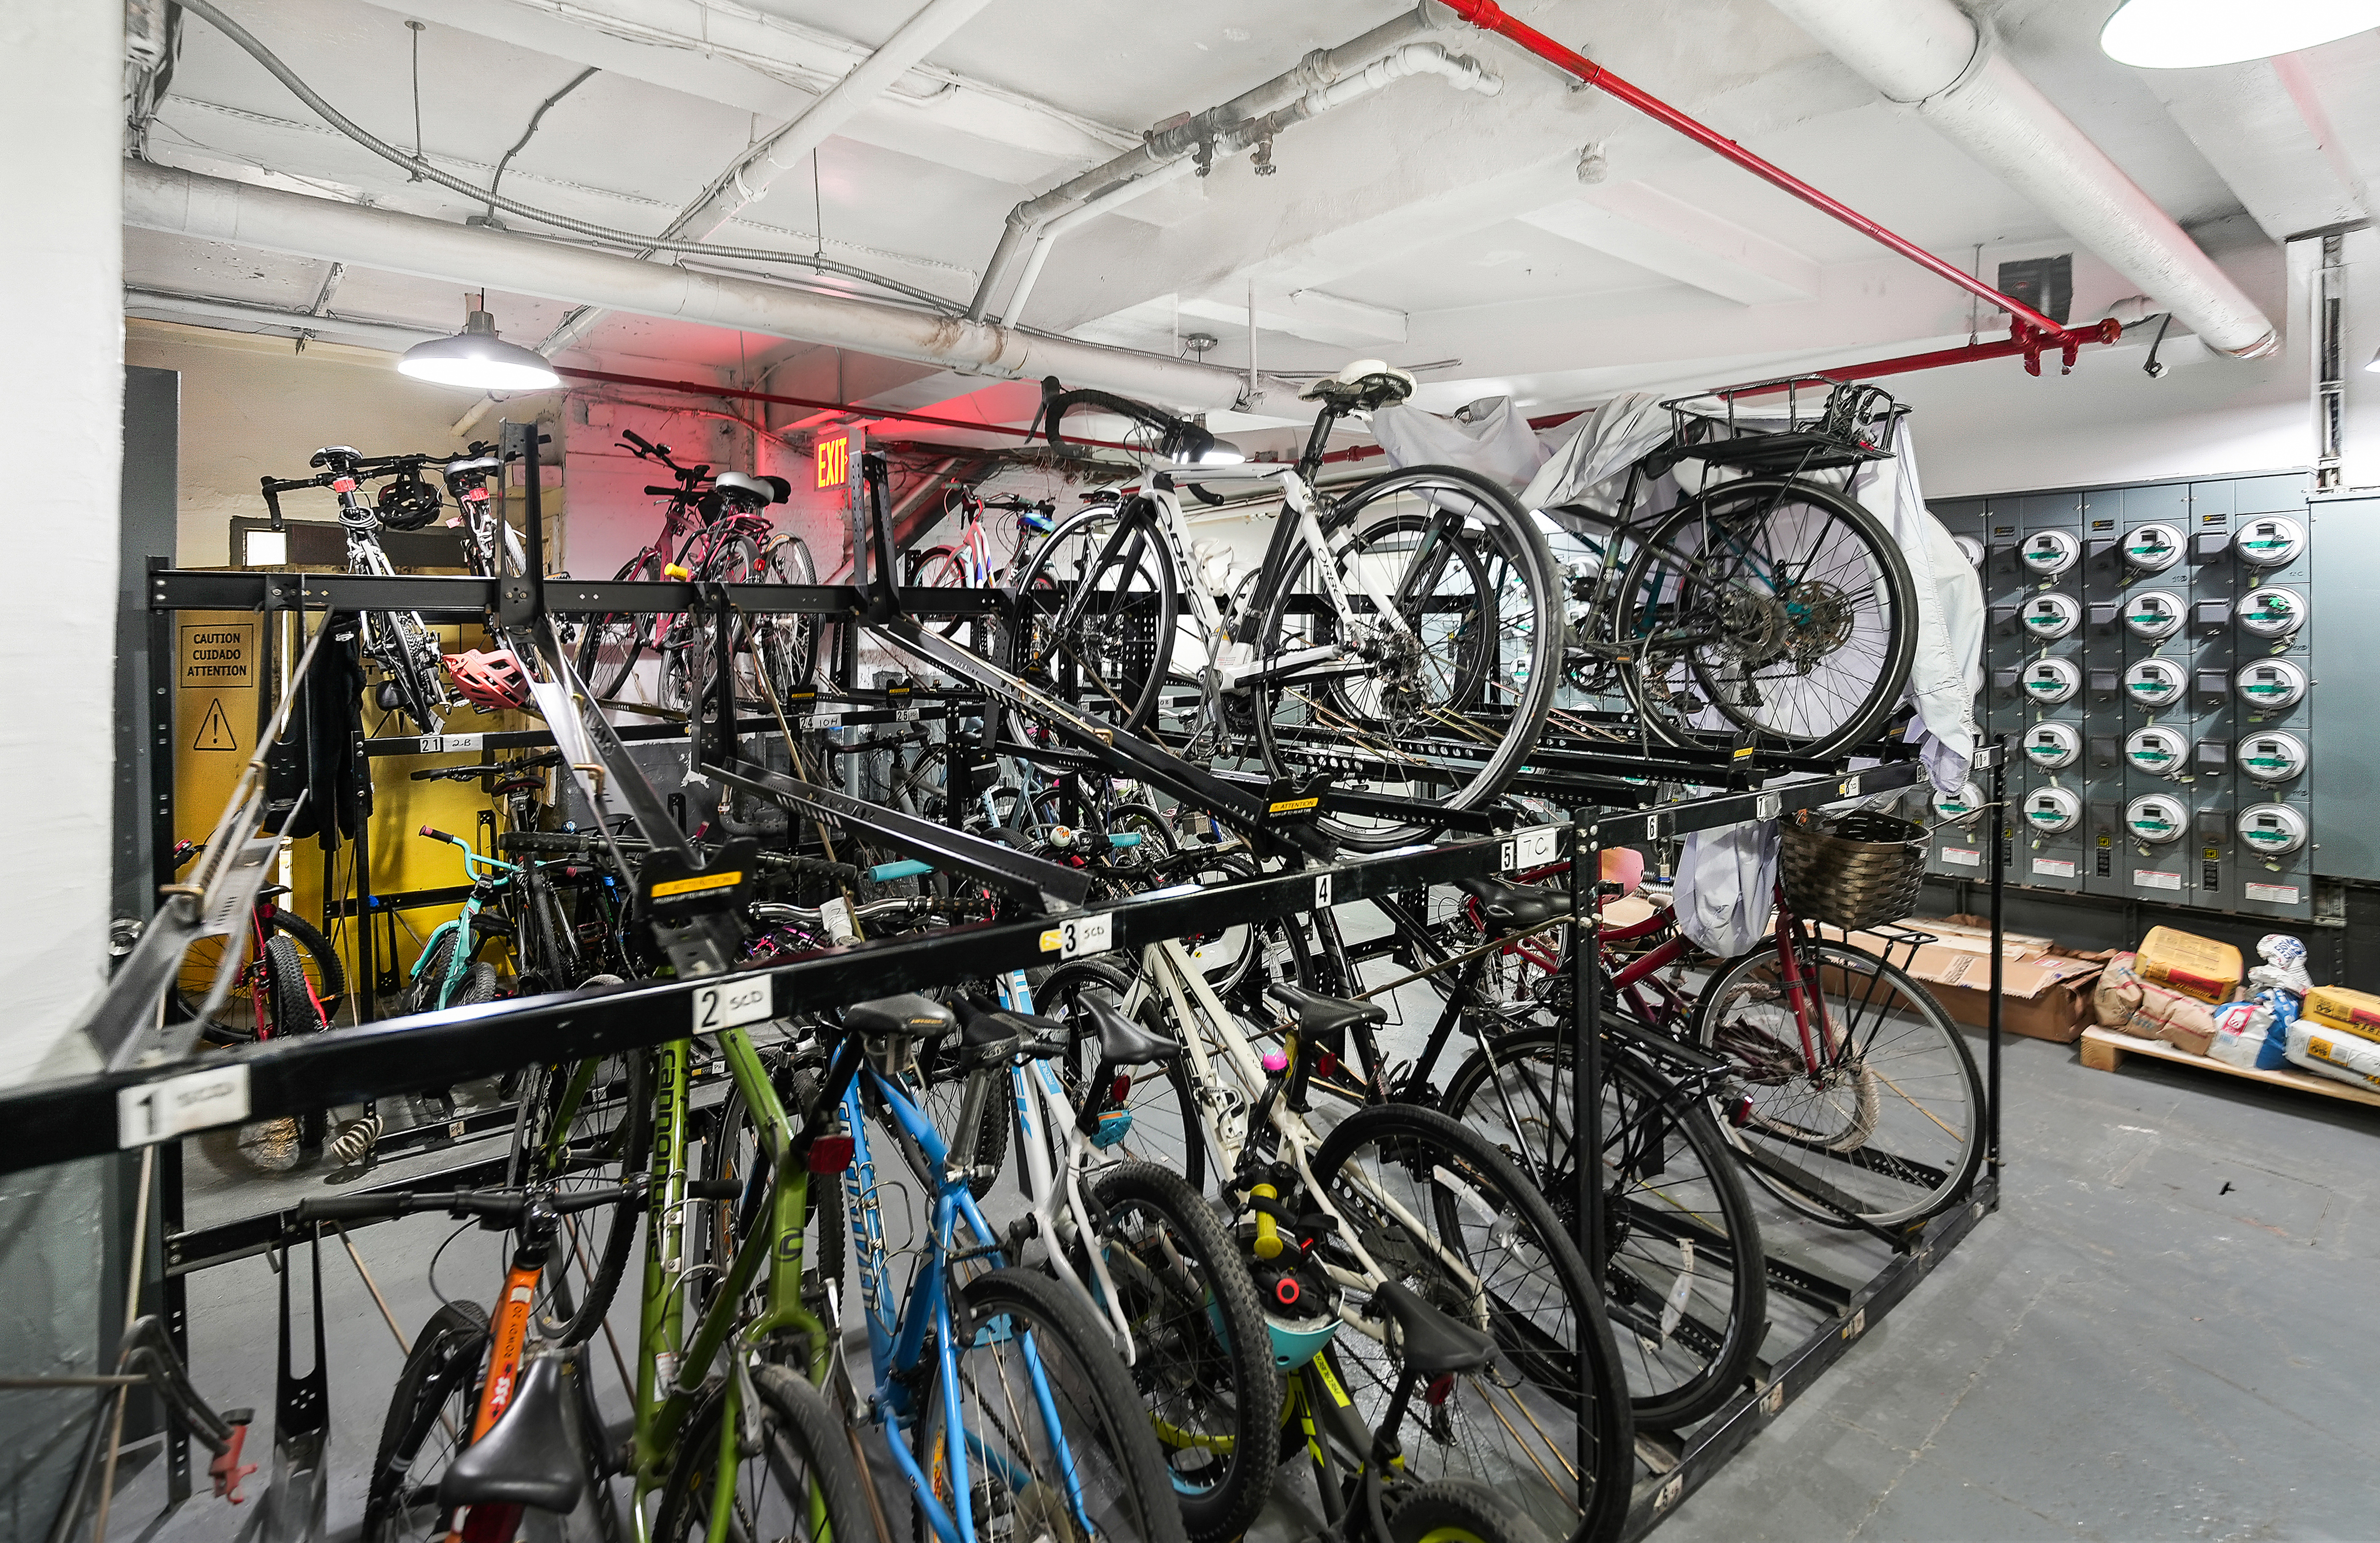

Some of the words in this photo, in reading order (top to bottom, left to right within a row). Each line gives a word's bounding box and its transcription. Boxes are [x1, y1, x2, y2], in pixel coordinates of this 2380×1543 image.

[818, 437, 847, 488] EXIT
[1318, 547, 1346, 614] ORBEA
[194, 633, 240, 644] CAUTION
[193, 649, 241, 660] CUIDADO
[187, 665, 247, 676] ATTENTION
[801, 717, 813, 729] 24
[897, 711, 908, 721] 25
[421, 738, 438, 751] 21
[1976, 753, 1982, 767] 10
[1280, 801, 1314, 810] ATTENTION
[1758, 799, 1763, 815] 7
[1650, 818, 1655, 838] 6
[1504, 845, 1510, 868] 5
[1523, 837, 1547, 858] 7C
[1319, 877, 1328, 903] 4
[1065, 924, 1076, 952] 3
[1084, 926, 1105, 940] SCD
[702, 991, 718, 1028] 2
[730, 990, 763, 1010] SCD
[138, 1093, 155, 1136] 1
[839, 1101, 875, 1310] SPCIALIZED
[504, 1323, 518, 1358] ROWDY
[512, 1306, 522, 1318] 20
[1315, 1355, 1342, 1395] PRECALIBER
